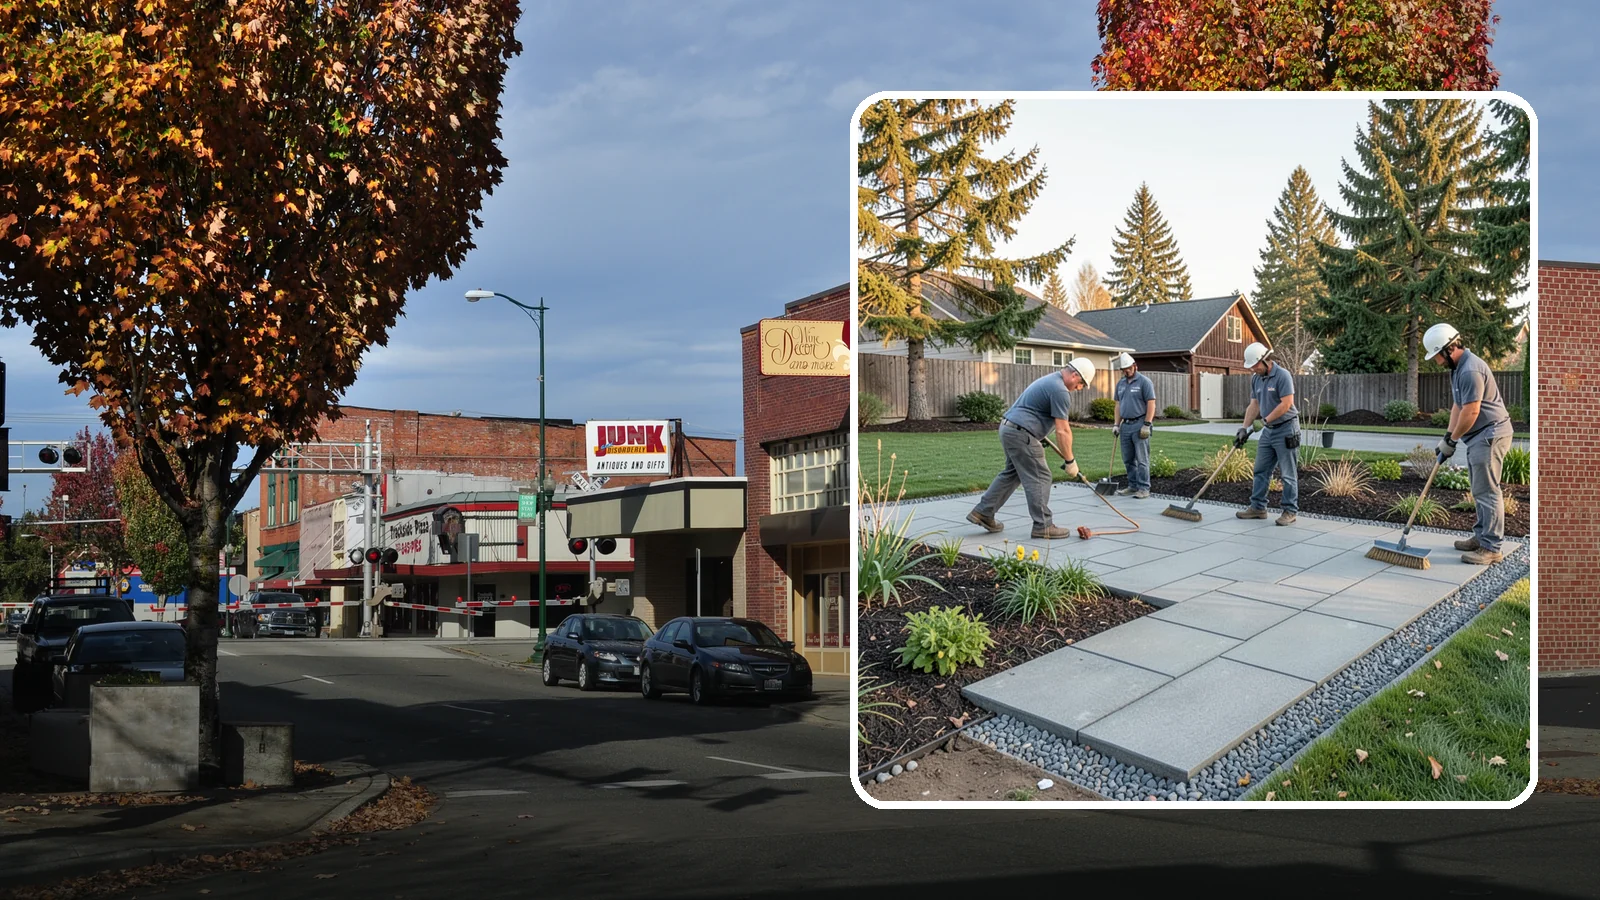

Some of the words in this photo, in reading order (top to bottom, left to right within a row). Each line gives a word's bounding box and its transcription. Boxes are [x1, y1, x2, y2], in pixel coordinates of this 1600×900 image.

[595, 425, 665, 457] JUNK
[607, 446, 646, 454] DISORDERLY
[596, 461, 628, 470] ANTIQUES
[631, 461, 644, 469] AND
[646, 461, 665, 469] GIFTS
[587, 476, 608, 492] SING
[414, 519, 429, 535] Pizza
